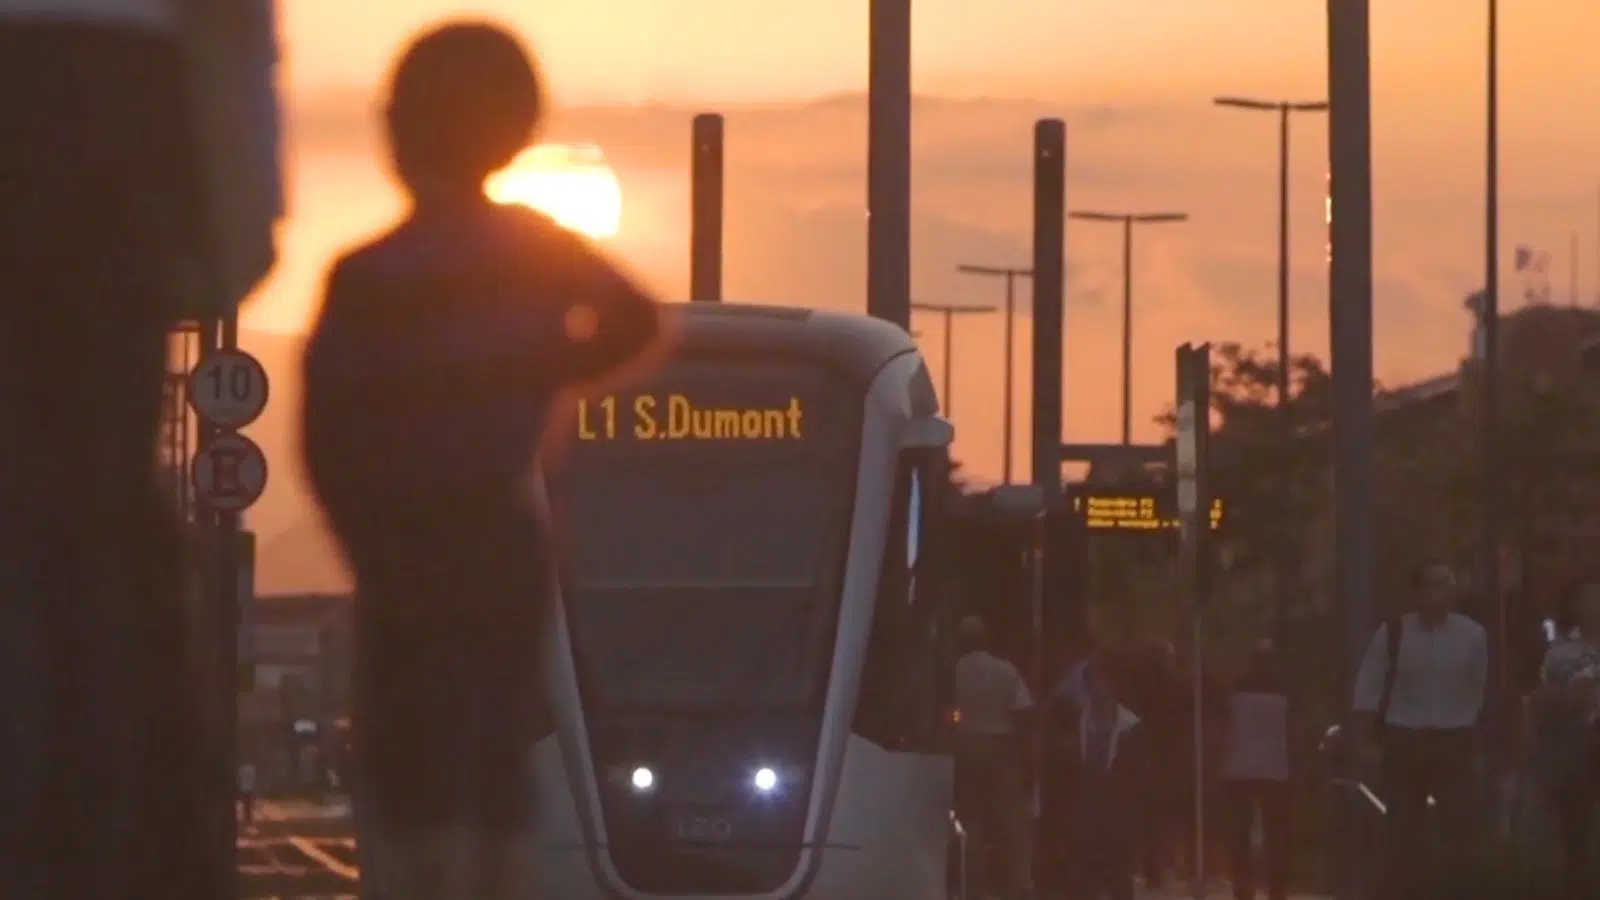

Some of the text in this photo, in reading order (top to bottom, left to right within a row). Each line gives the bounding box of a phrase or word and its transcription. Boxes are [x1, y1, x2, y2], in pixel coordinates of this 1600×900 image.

[207, 364, 250, 400] 10
[577, 394, 803, 440] L1 S.Dumont
